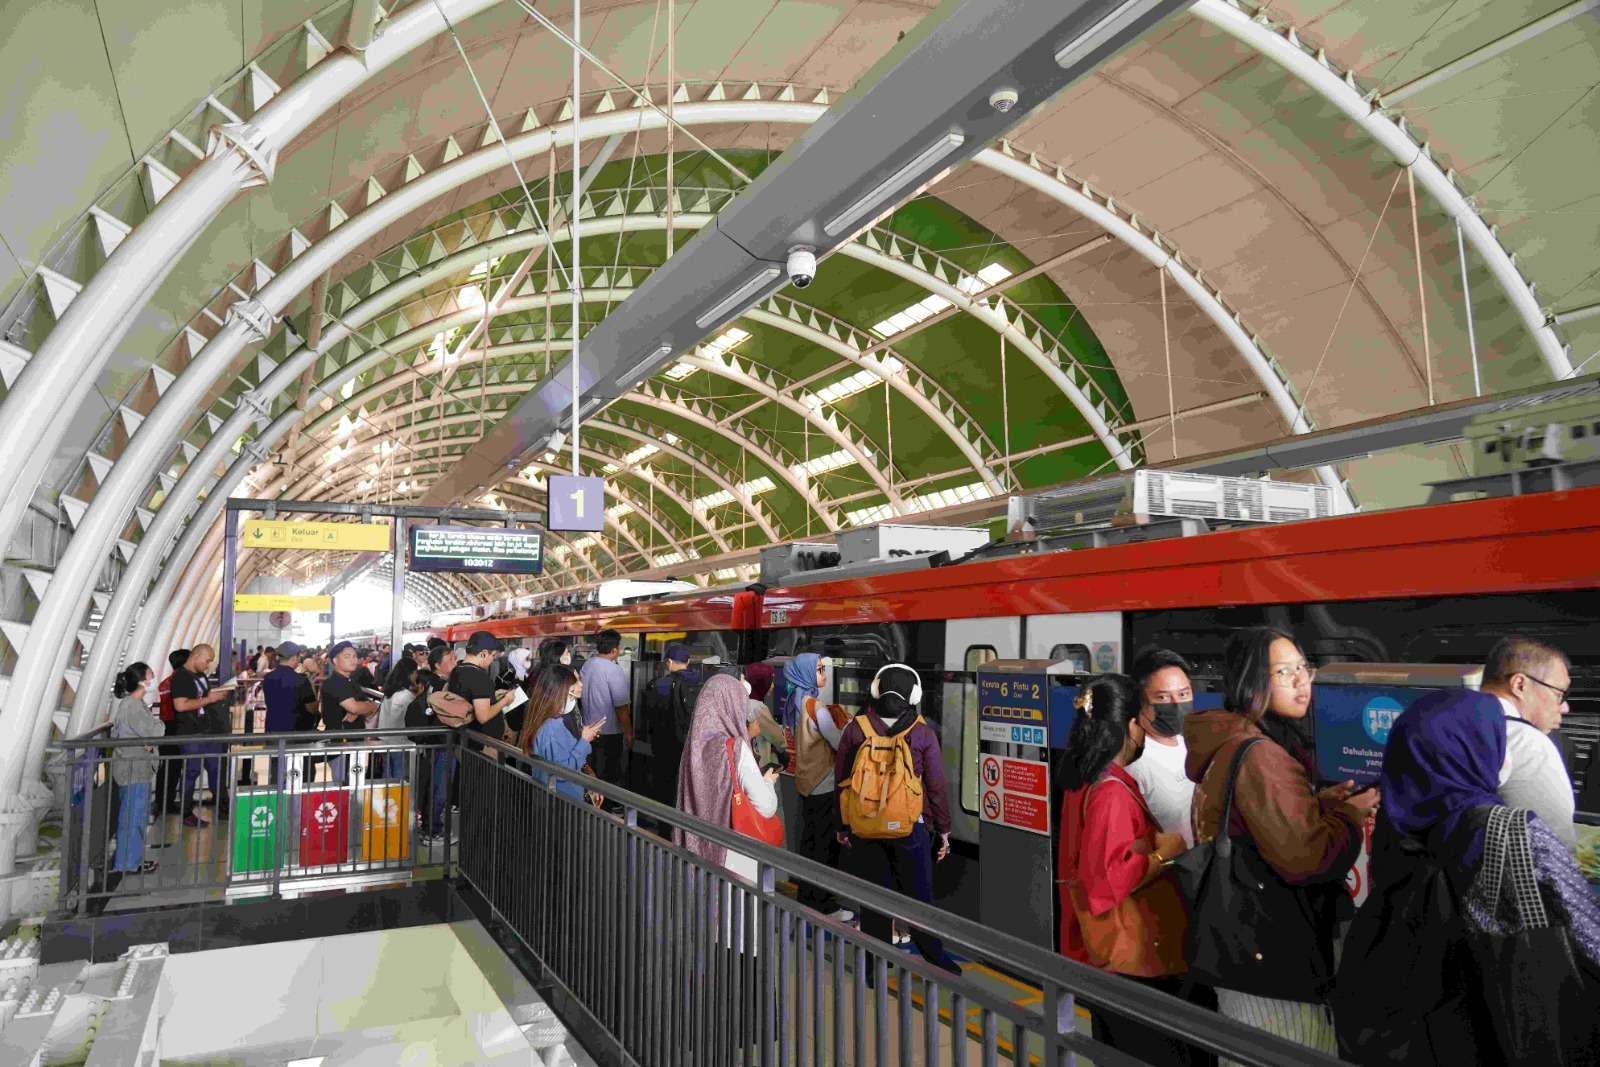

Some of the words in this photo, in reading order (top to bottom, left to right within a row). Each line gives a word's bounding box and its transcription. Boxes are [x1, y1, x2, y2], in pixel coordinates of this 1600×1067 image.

[569, 489, 584, 518] 1
[292, 527, 319, 536] Keluar
[1000, 682, 1008, 697] 6
[1013, 682, 1029, 691] Pintu
[1032, 684, 1040, 699] 2
